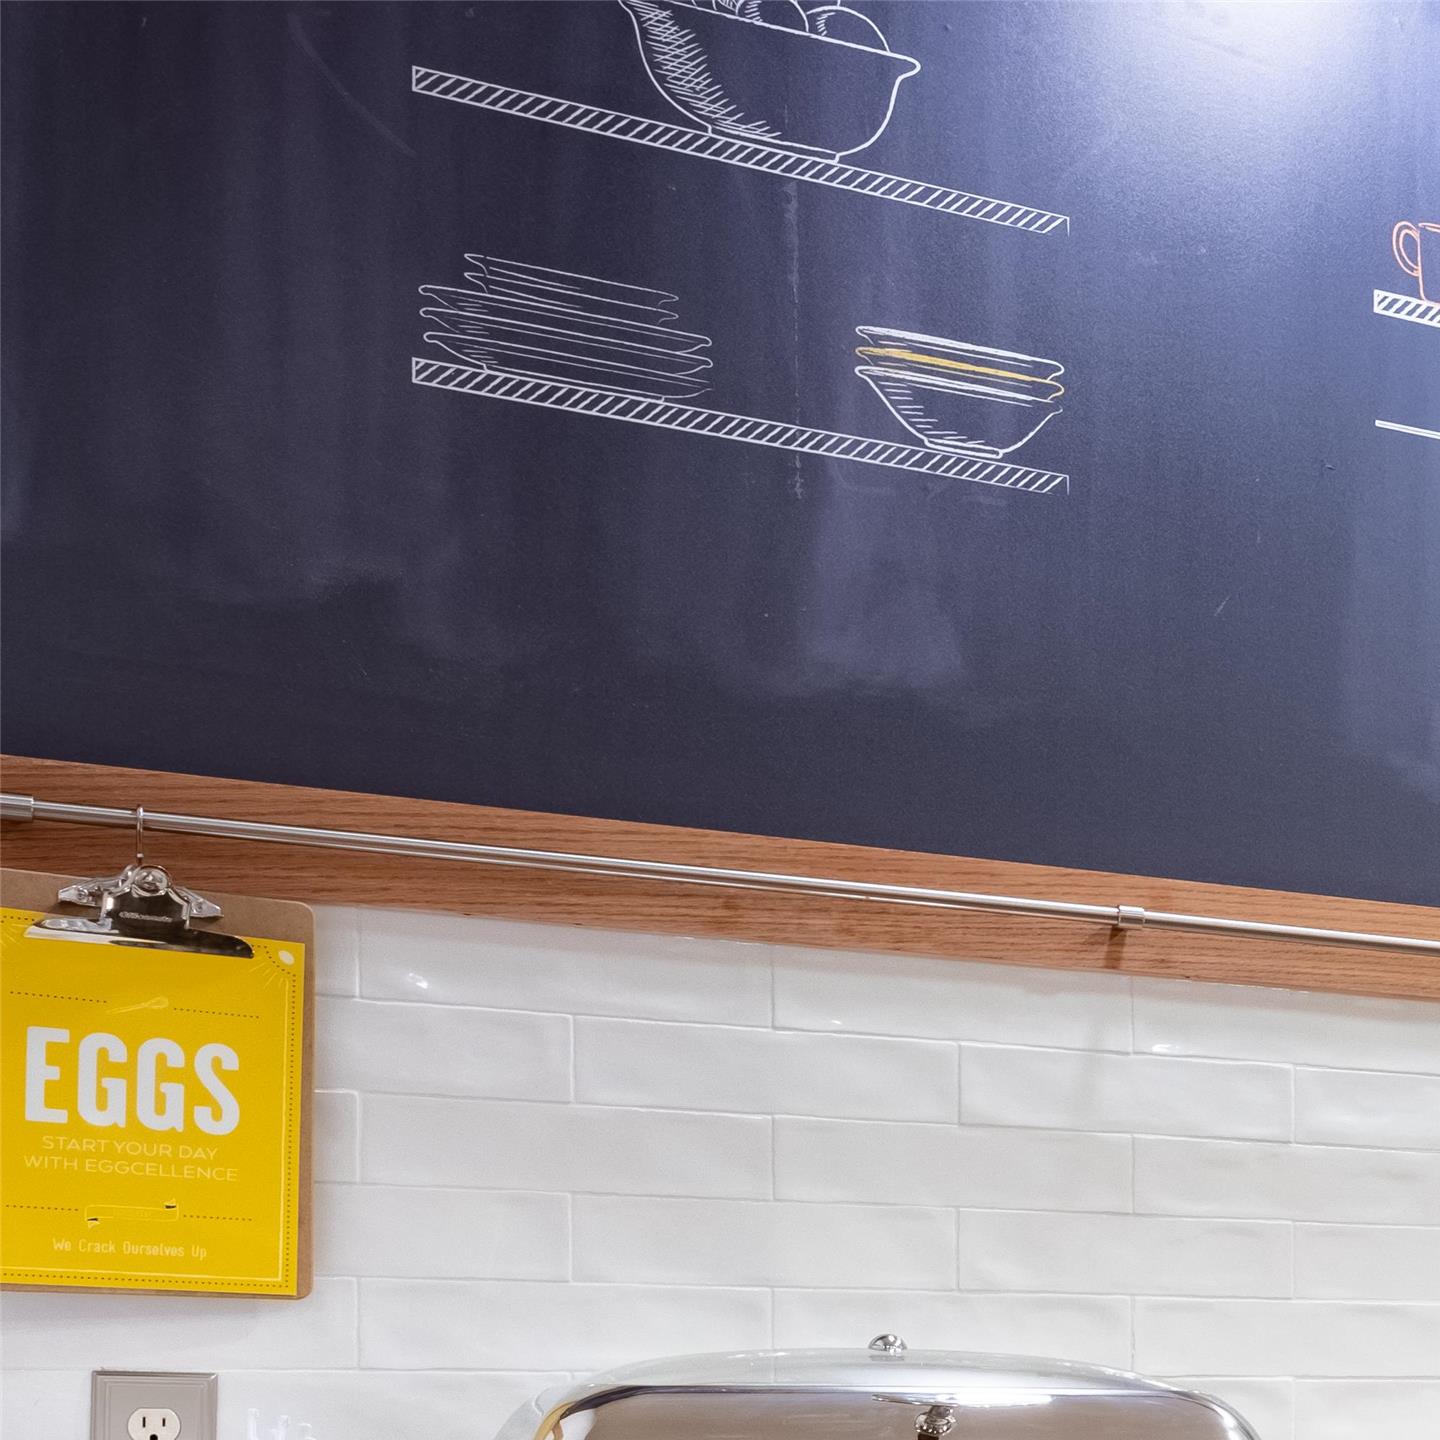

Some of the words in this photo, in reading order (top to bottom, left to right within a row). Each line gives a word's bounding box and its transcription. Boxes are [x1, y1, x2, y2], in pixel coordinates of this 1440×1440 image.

[25, 1025, 240, 1135] EGGS
[42, 1135, 110, 1152] START
[113, 1139, 173, 1157] YOUR
[179, 1145, 218, 1161] DAY
[24, 1155, 78, 1171] WITH
[85, 1158, 239, 1182] EGGCELLENCE
[52, 1238, 72, 1252] We
[79, 1238, 116, 1255] Crack
[122, 1240, 185, 1257] Ourselves
[191, 1245, 207, 1261] Up
